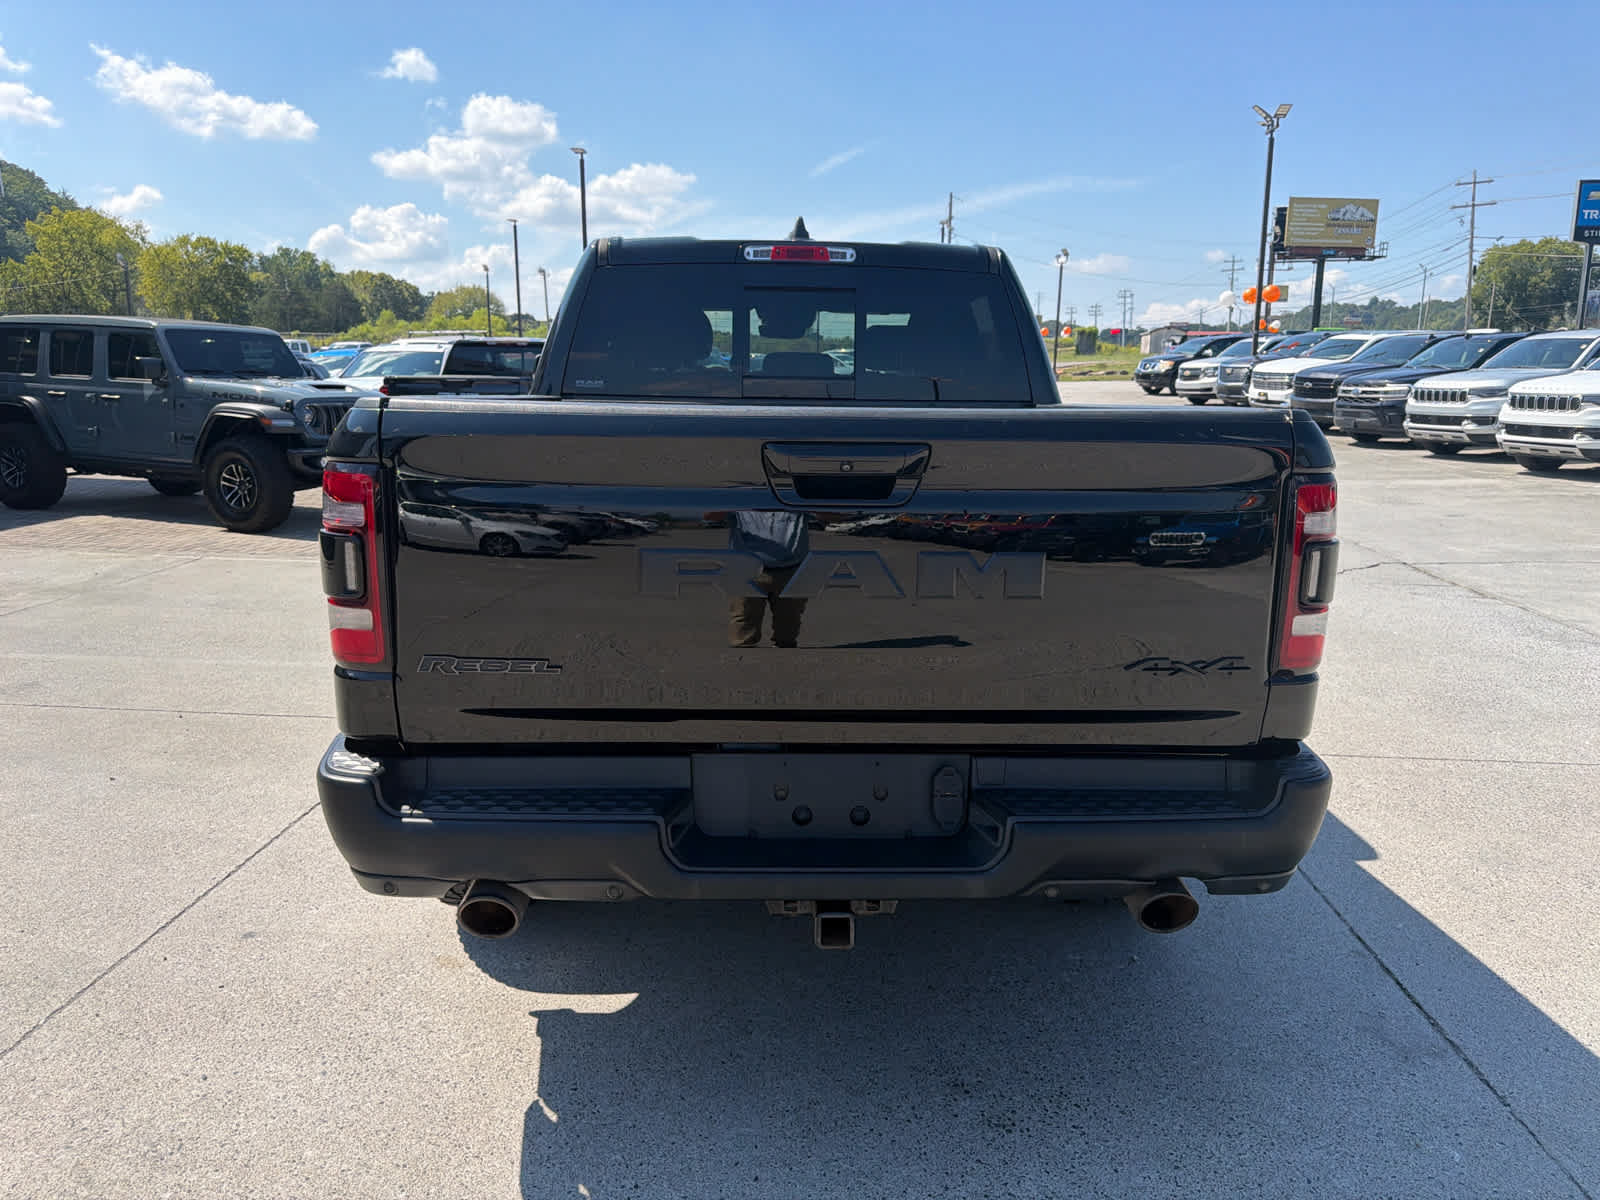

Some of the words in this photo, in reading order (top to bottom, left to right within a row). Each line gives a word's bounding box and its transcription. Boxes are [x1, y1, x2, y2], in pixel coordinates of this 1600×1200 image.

[1582, 209, 1600, 220] TR
[640, 548, 1047, 599] RAM
[417, 654, 562, 675] REBEL
